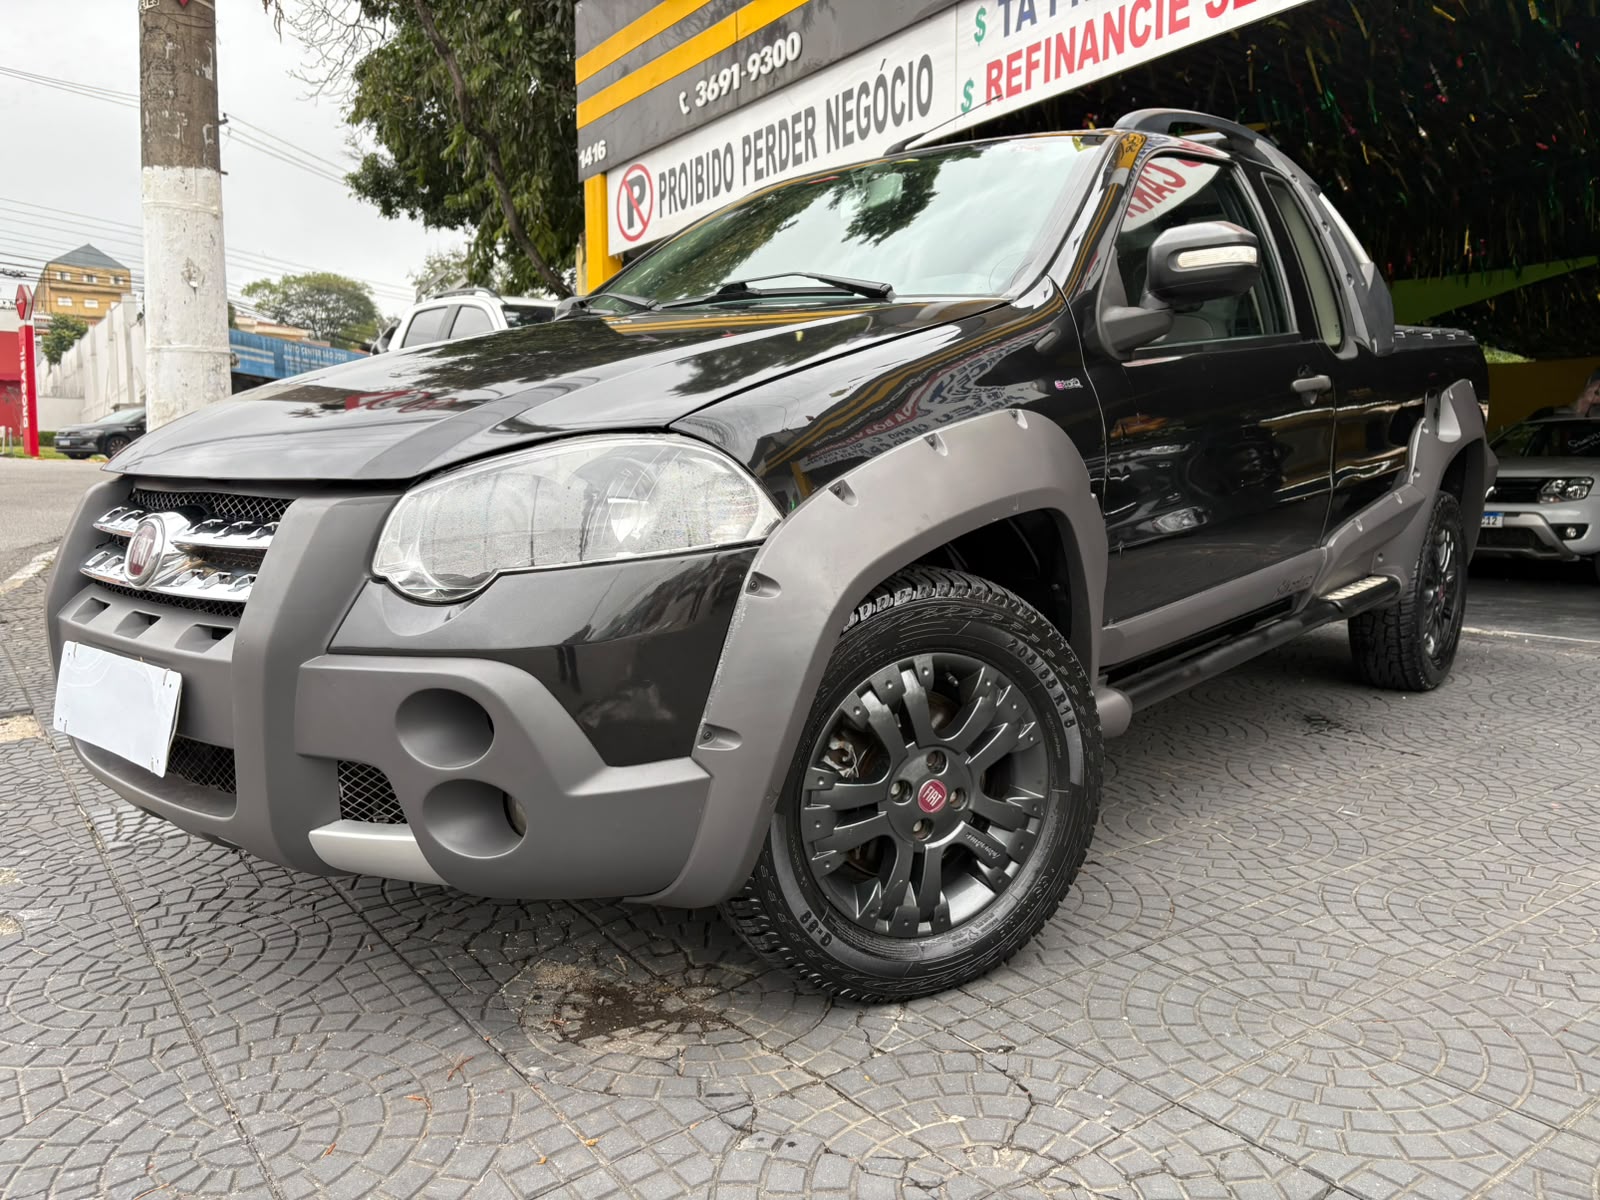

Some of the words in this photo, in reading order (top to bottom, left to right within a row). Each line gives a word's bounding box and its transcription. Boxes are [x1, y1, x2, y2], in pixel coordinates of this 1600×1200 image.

[695, 31, 802, 107] 3691-9300
[986, 0, 1190, 106] REFINANCIE
[579, 140, 606, 169] 1416
[658, 142, 735, 218] PROIBIDO
[742, 105, 819, 187] PERDER
[825, 53, 934, 155] NEGÓCIO
[20, 345, 28, 428] DROGASIL
[922, 785, 942, 807] FIAT
